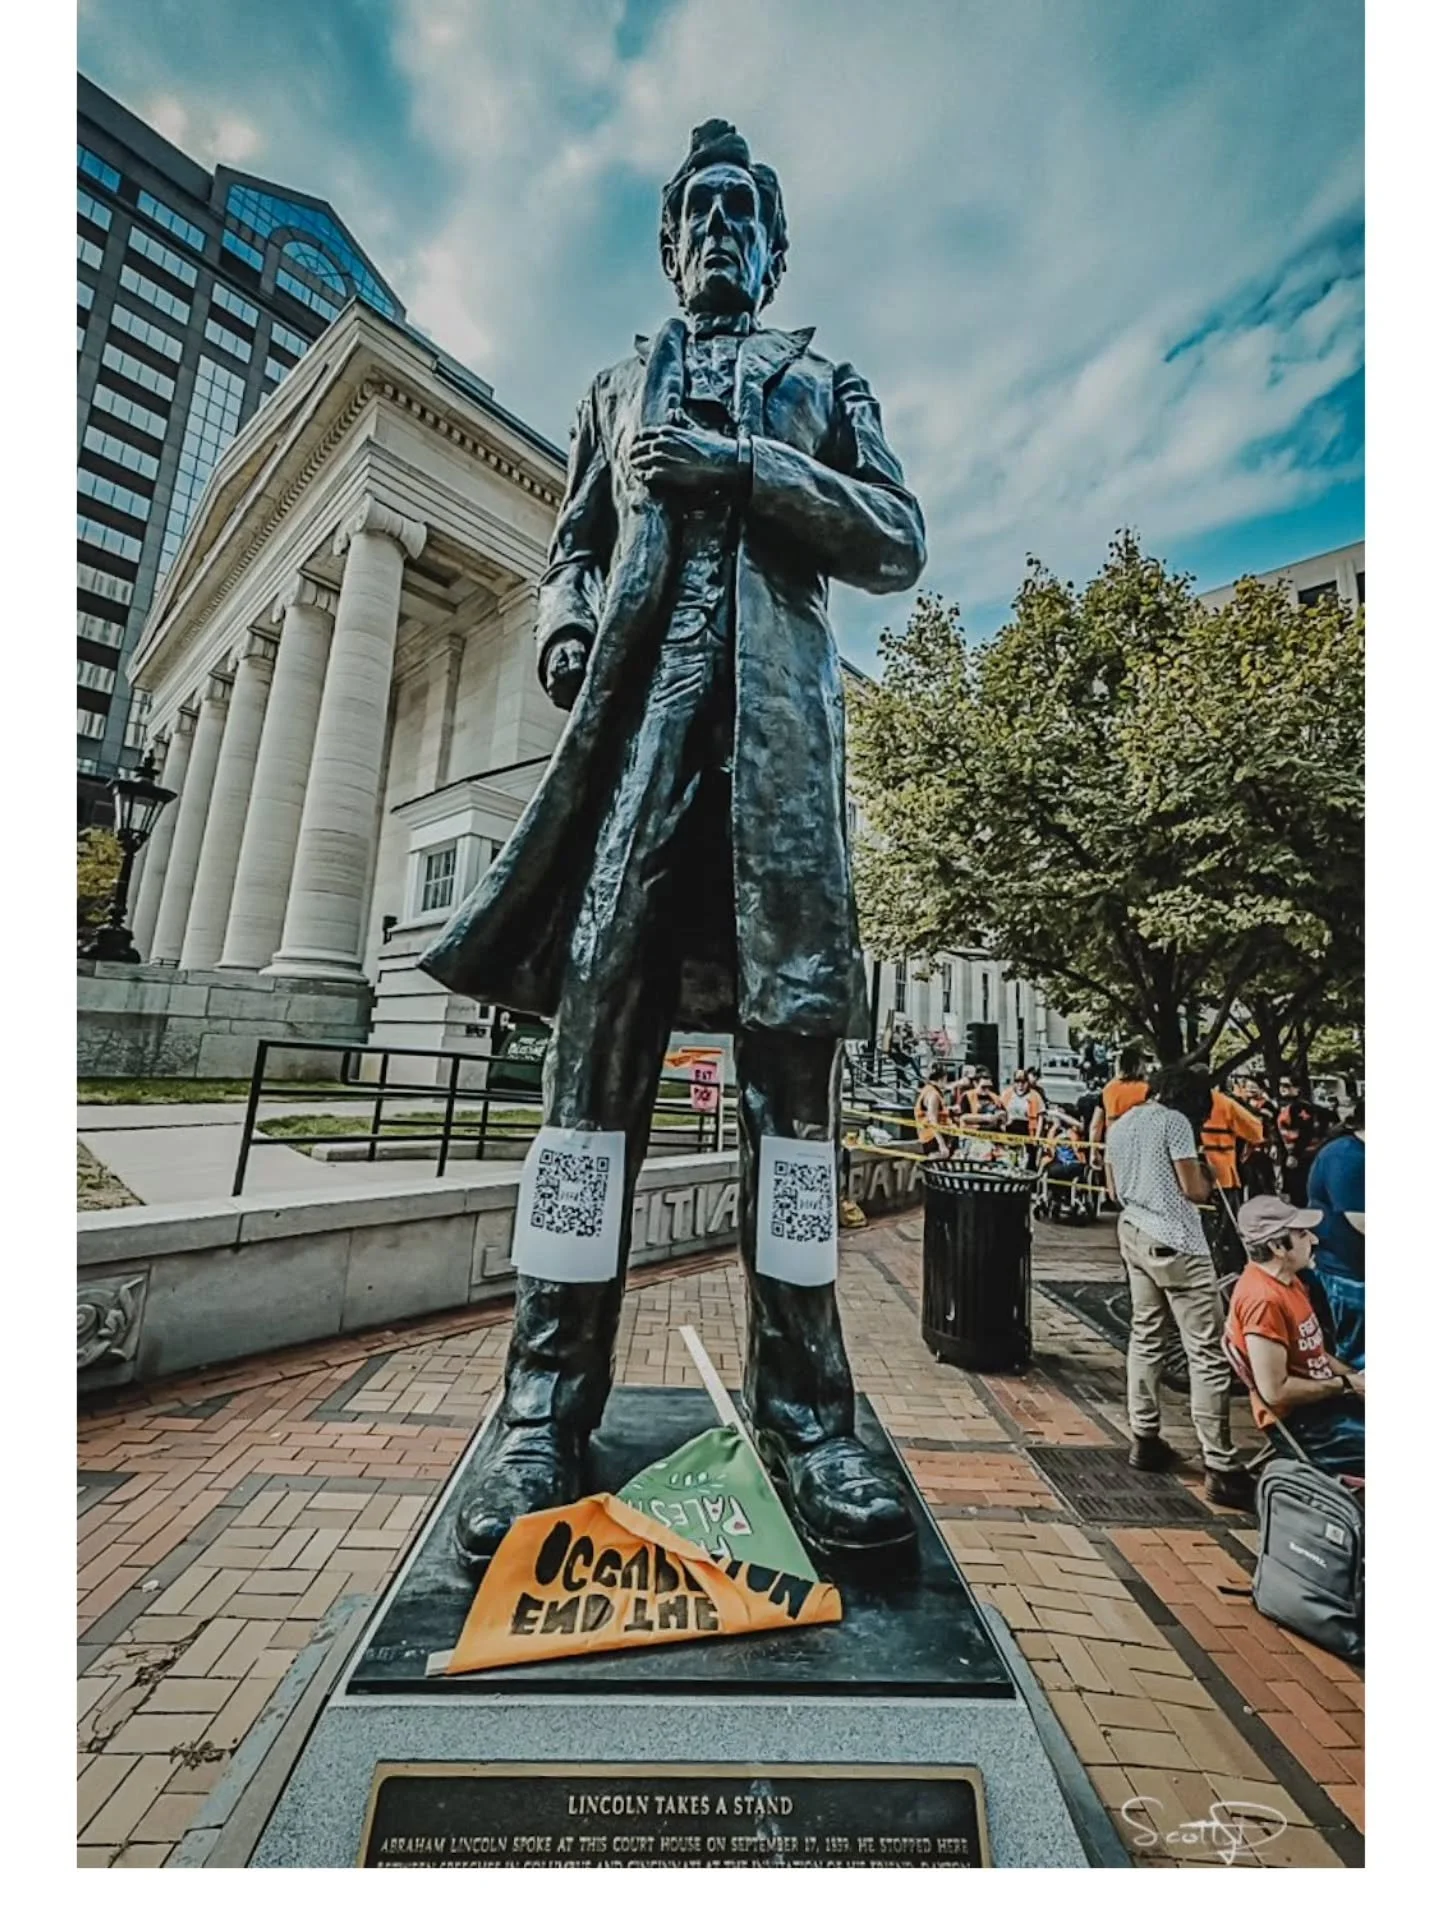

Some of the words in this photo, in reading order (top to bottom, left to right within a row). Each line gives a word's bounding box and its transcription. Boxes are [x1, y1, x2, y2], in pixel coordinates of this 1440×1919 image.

[568, 1795, 650, 1815] LINCOLN
[654, 1795, 711, 1815] TAKES
[715, 1795, 729, 1815] A
[733, 1795, 794, 1815] STAND
[380, 1836, 447, 1853] ABRAHAM
[450, 1836, 508, 1853] LINCOLN
[512, 1836, 553, 1853] SPOKE
[556, 1836, 575, 1853] AT
[578, 1836, 608, 1853] THIS
[612, 1836, 656, 1853] COURT
[660, 1836, 702, 1853] HOUSE
[706, 1836, 727, 1853] ON
[730, 1836, 799, 1853] SEPTEMBER
[857, 1836, 877, 1853] HE
